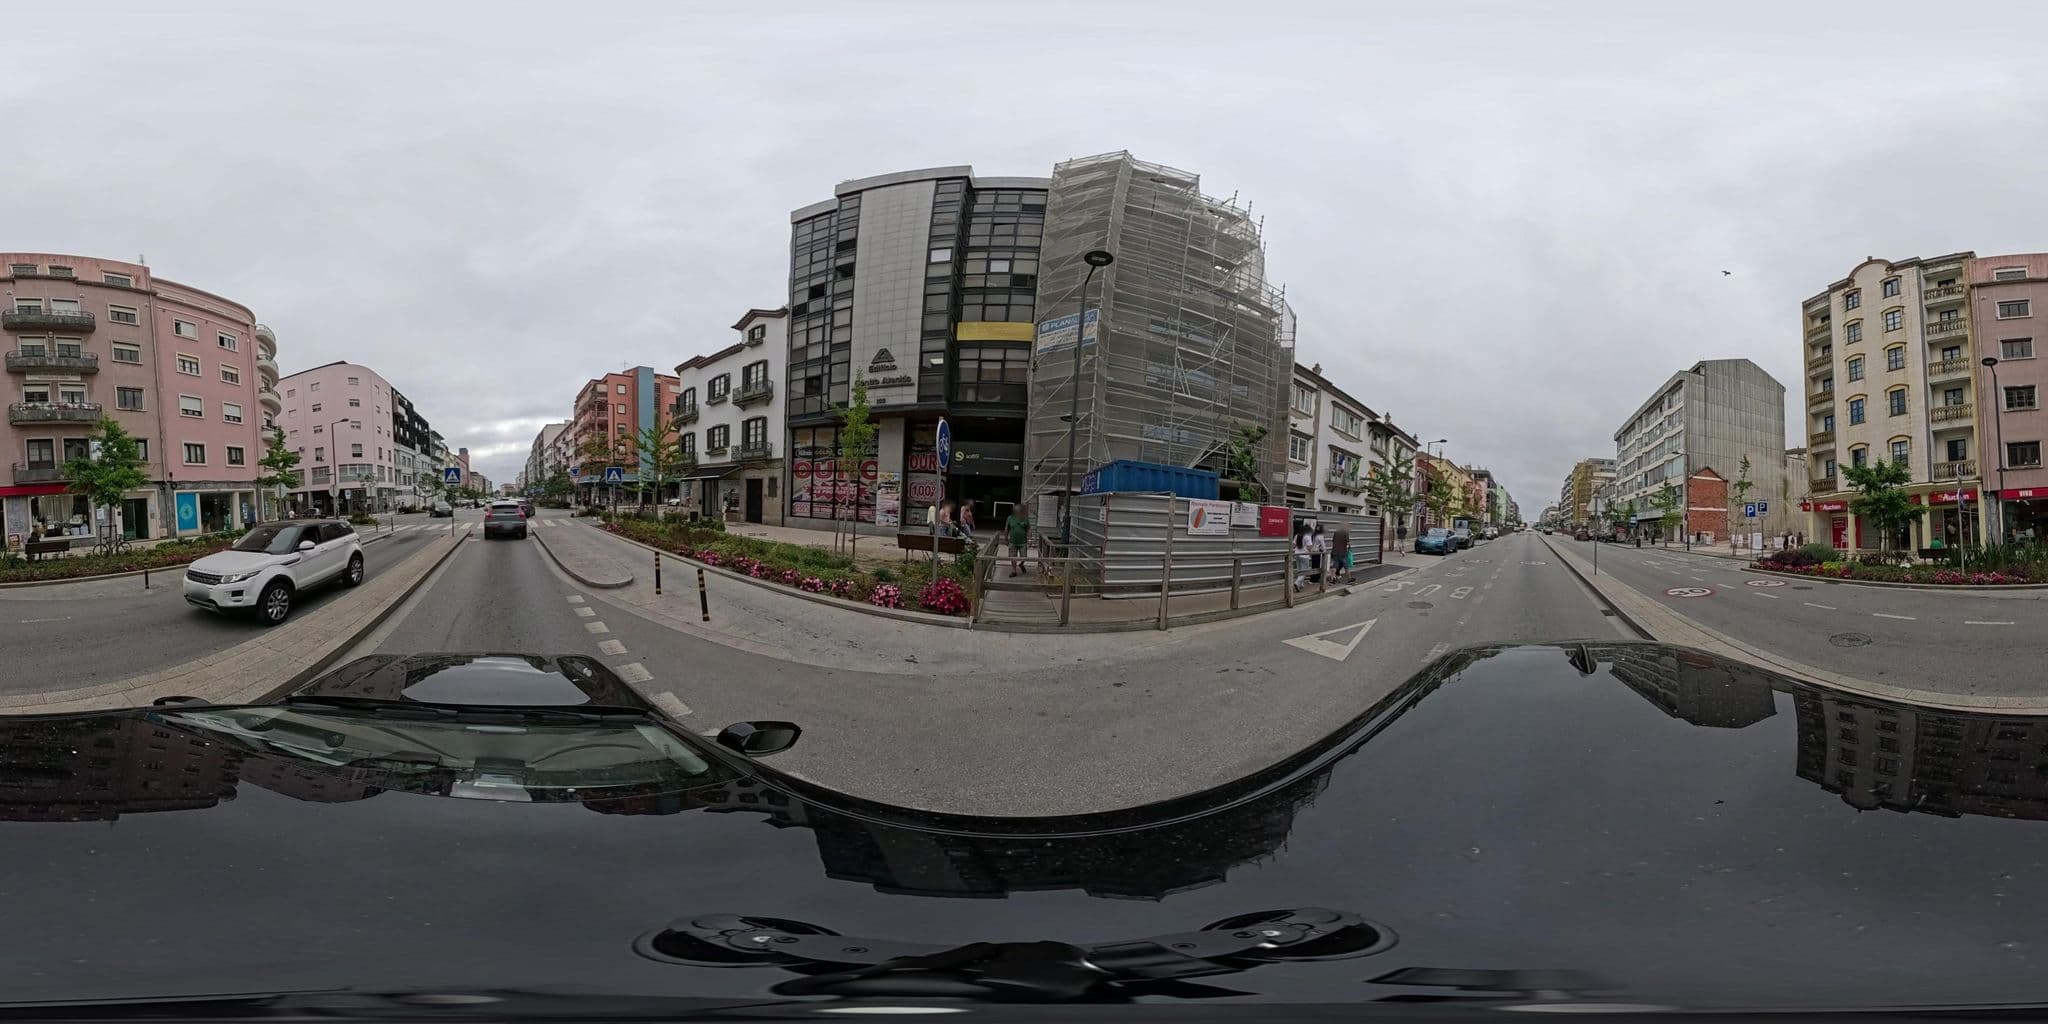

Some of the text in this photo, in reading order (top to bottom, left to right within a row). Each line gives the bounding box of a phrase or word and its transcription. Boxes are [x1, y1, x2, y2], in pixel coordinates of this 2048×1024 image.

[1942, 493, 1970, 502] Aucn
[1747, 506, 1754, 517] P
[1669, 588, 1707, 596] 30
